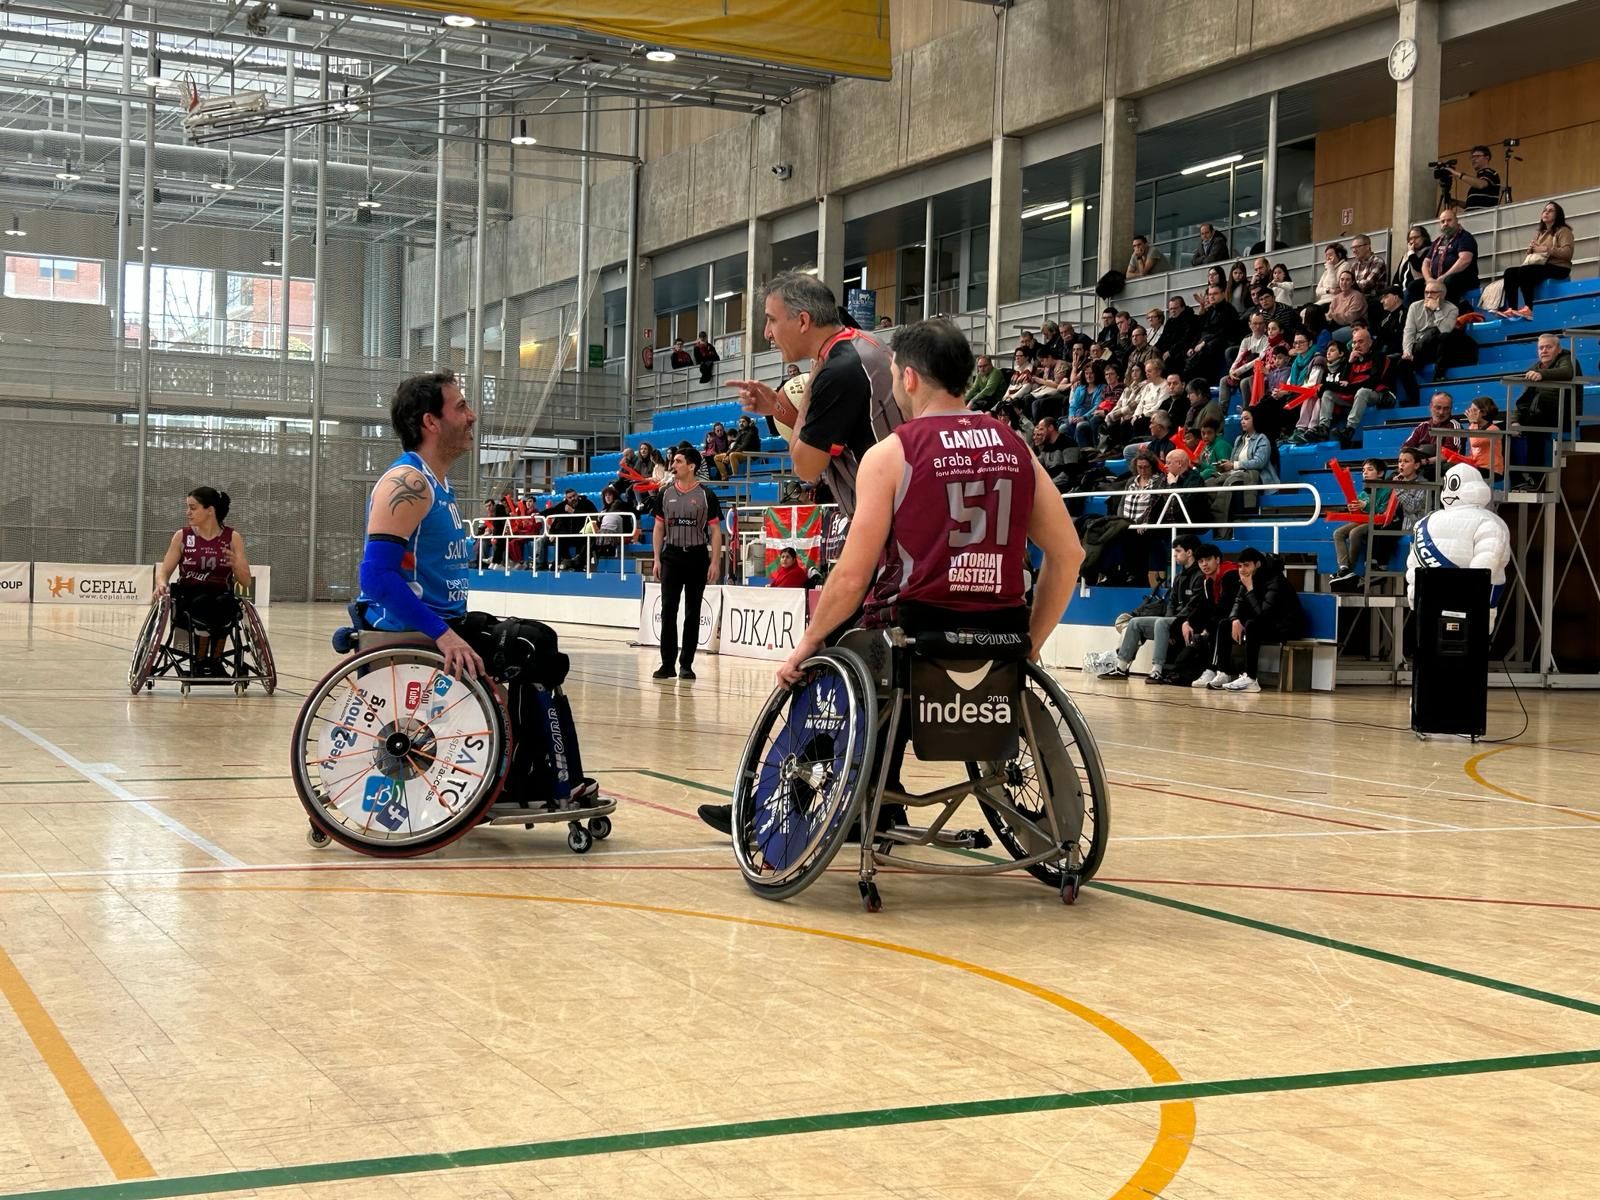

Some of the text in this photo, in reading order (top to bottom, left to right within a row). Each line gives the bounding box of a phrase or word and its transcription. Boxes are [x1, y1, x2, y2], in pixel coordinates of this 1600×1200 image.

[939, 428, 1004, 449] GANDIA
[933, 452, 972, 468] araba
[946, 478, 1013, 548] 51
[200, 556, 217, 570] 14
[949, 552, 996, 569] VITORIA
[948, 568, 996, 584] GASTEIZ
[80, 579, 137, 594] CEPIAL
[730, 608, 795, 650] DIKAR
[408, 686, 420, 705] Tube
[420, 688, 433, 704] You
[987, 695, 1009, 703] 2010
[364, 694, 386, 728] .org
[919, 692, 1012, 724] indesa
[321, 688, 368, 771] free2move
[439, 735, 484, 808] SALTO
